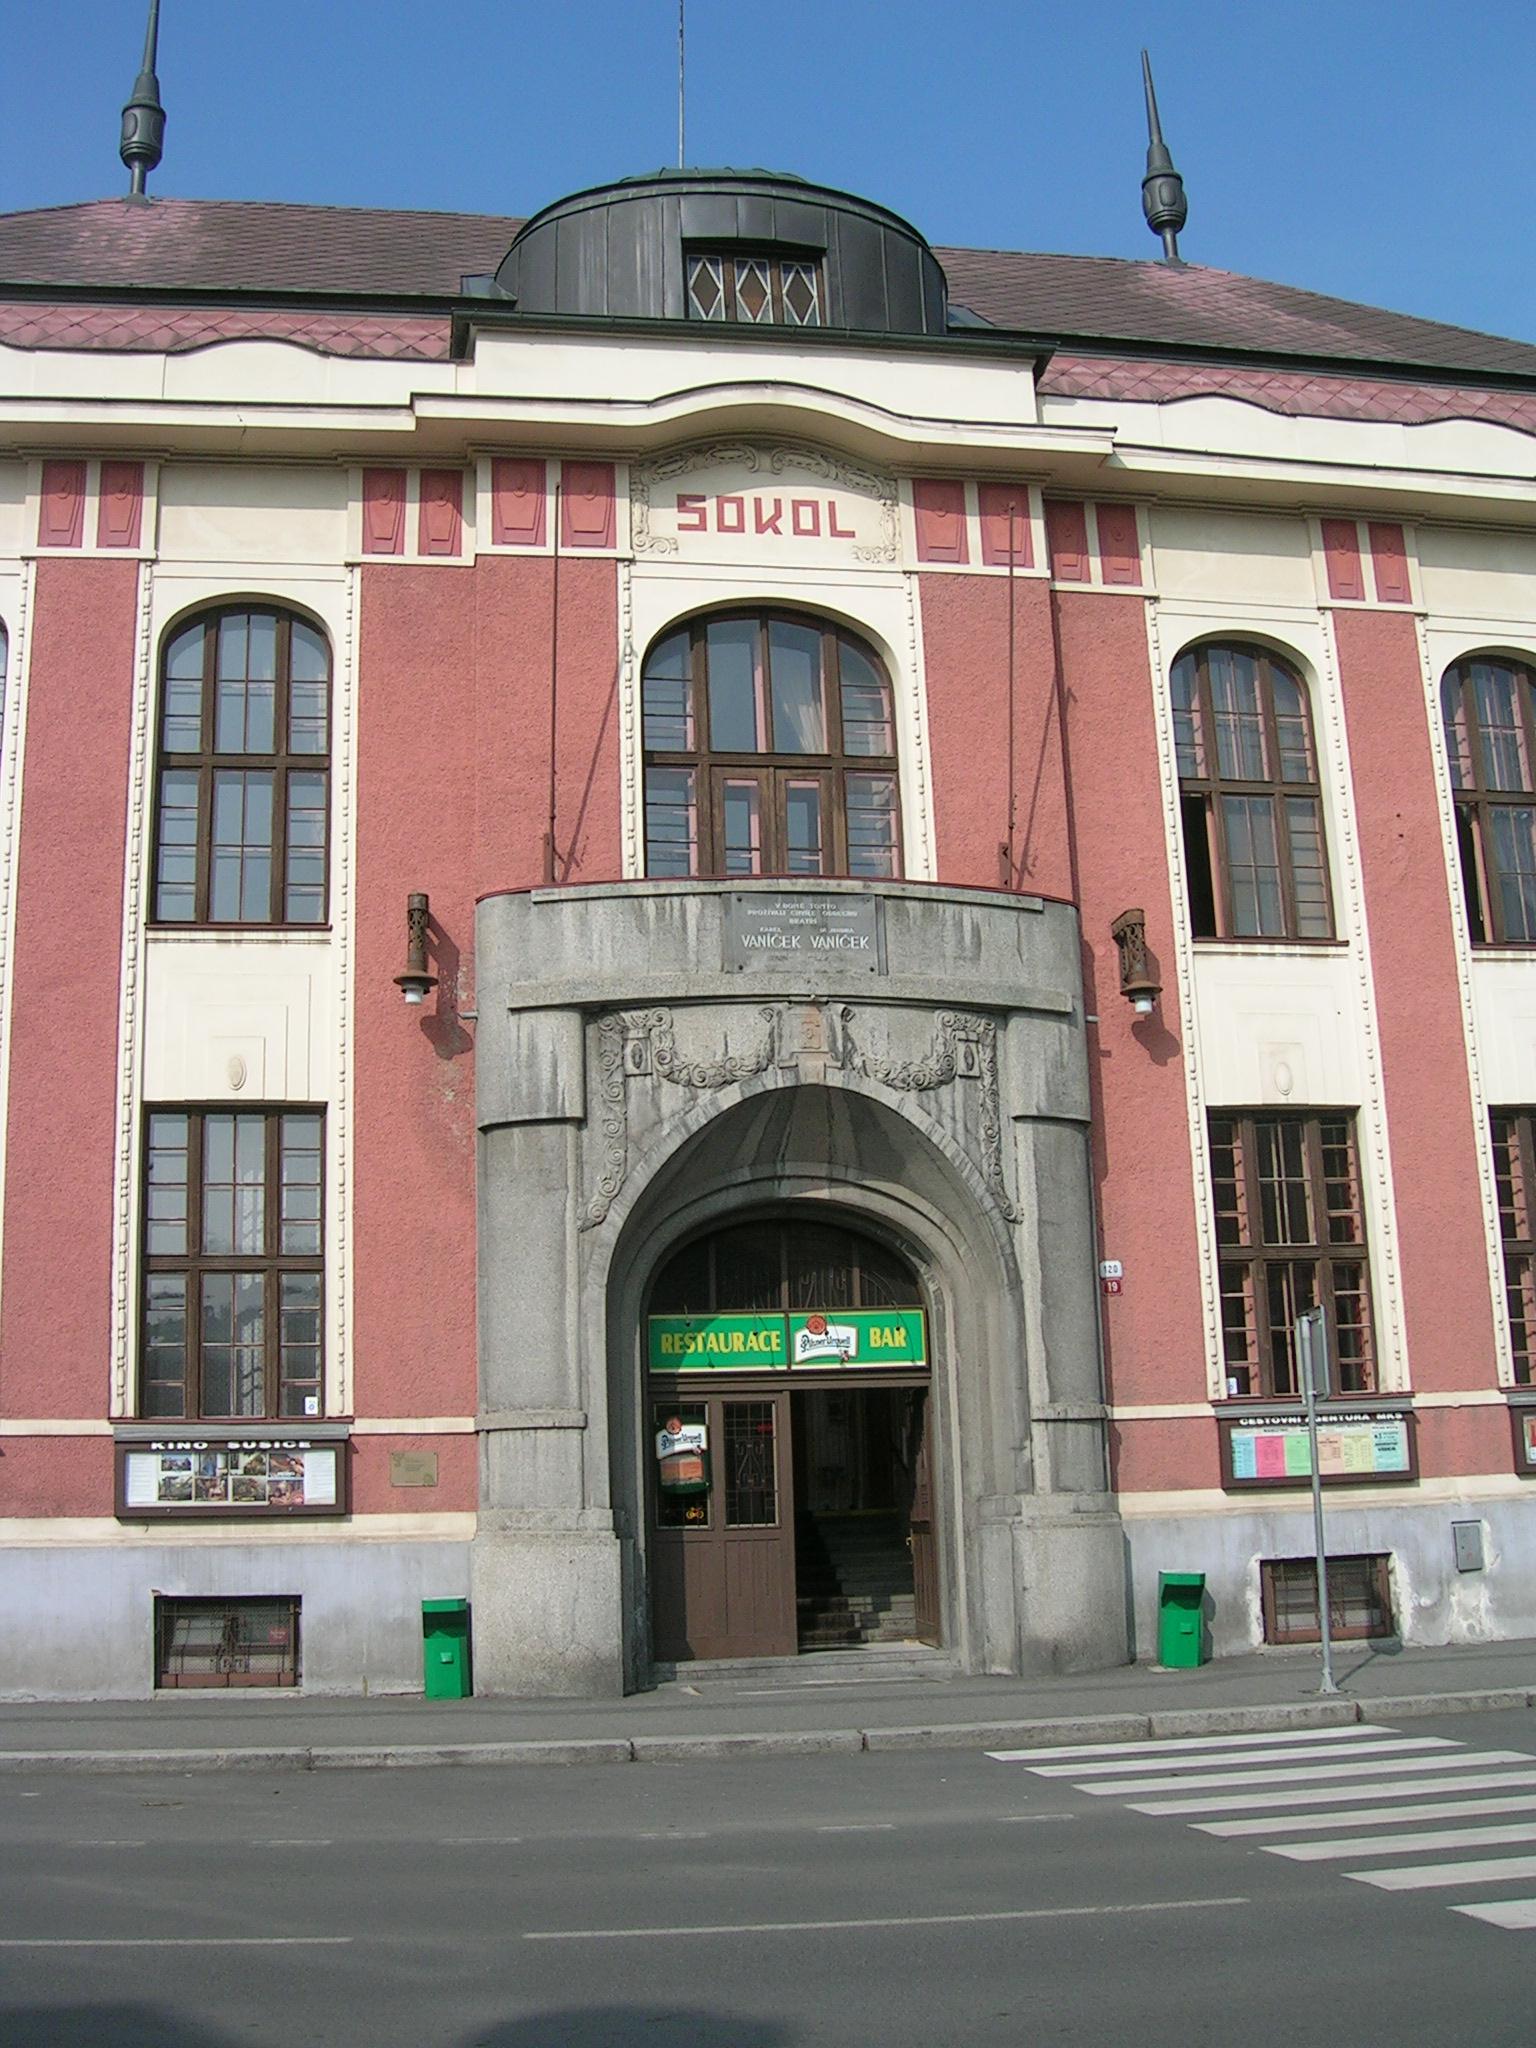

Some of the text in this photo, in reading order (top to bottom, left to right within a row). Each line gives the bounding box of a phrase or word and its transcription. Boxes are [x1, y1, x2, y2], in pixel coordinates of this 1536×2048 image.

[677, 494, 855, 538] SOKOL
[741, 933, 870, 950] VANÍČEK VANÍČEK
[1103, 1264, 1119, 1274] 120
[1107, 1281, 1118, 1292] 19
[660, 1330, 781, 1354] RESTAURACE
[869, 1326, 907, 1348] BAR
[151, 1441, 208, 1450] KINO
